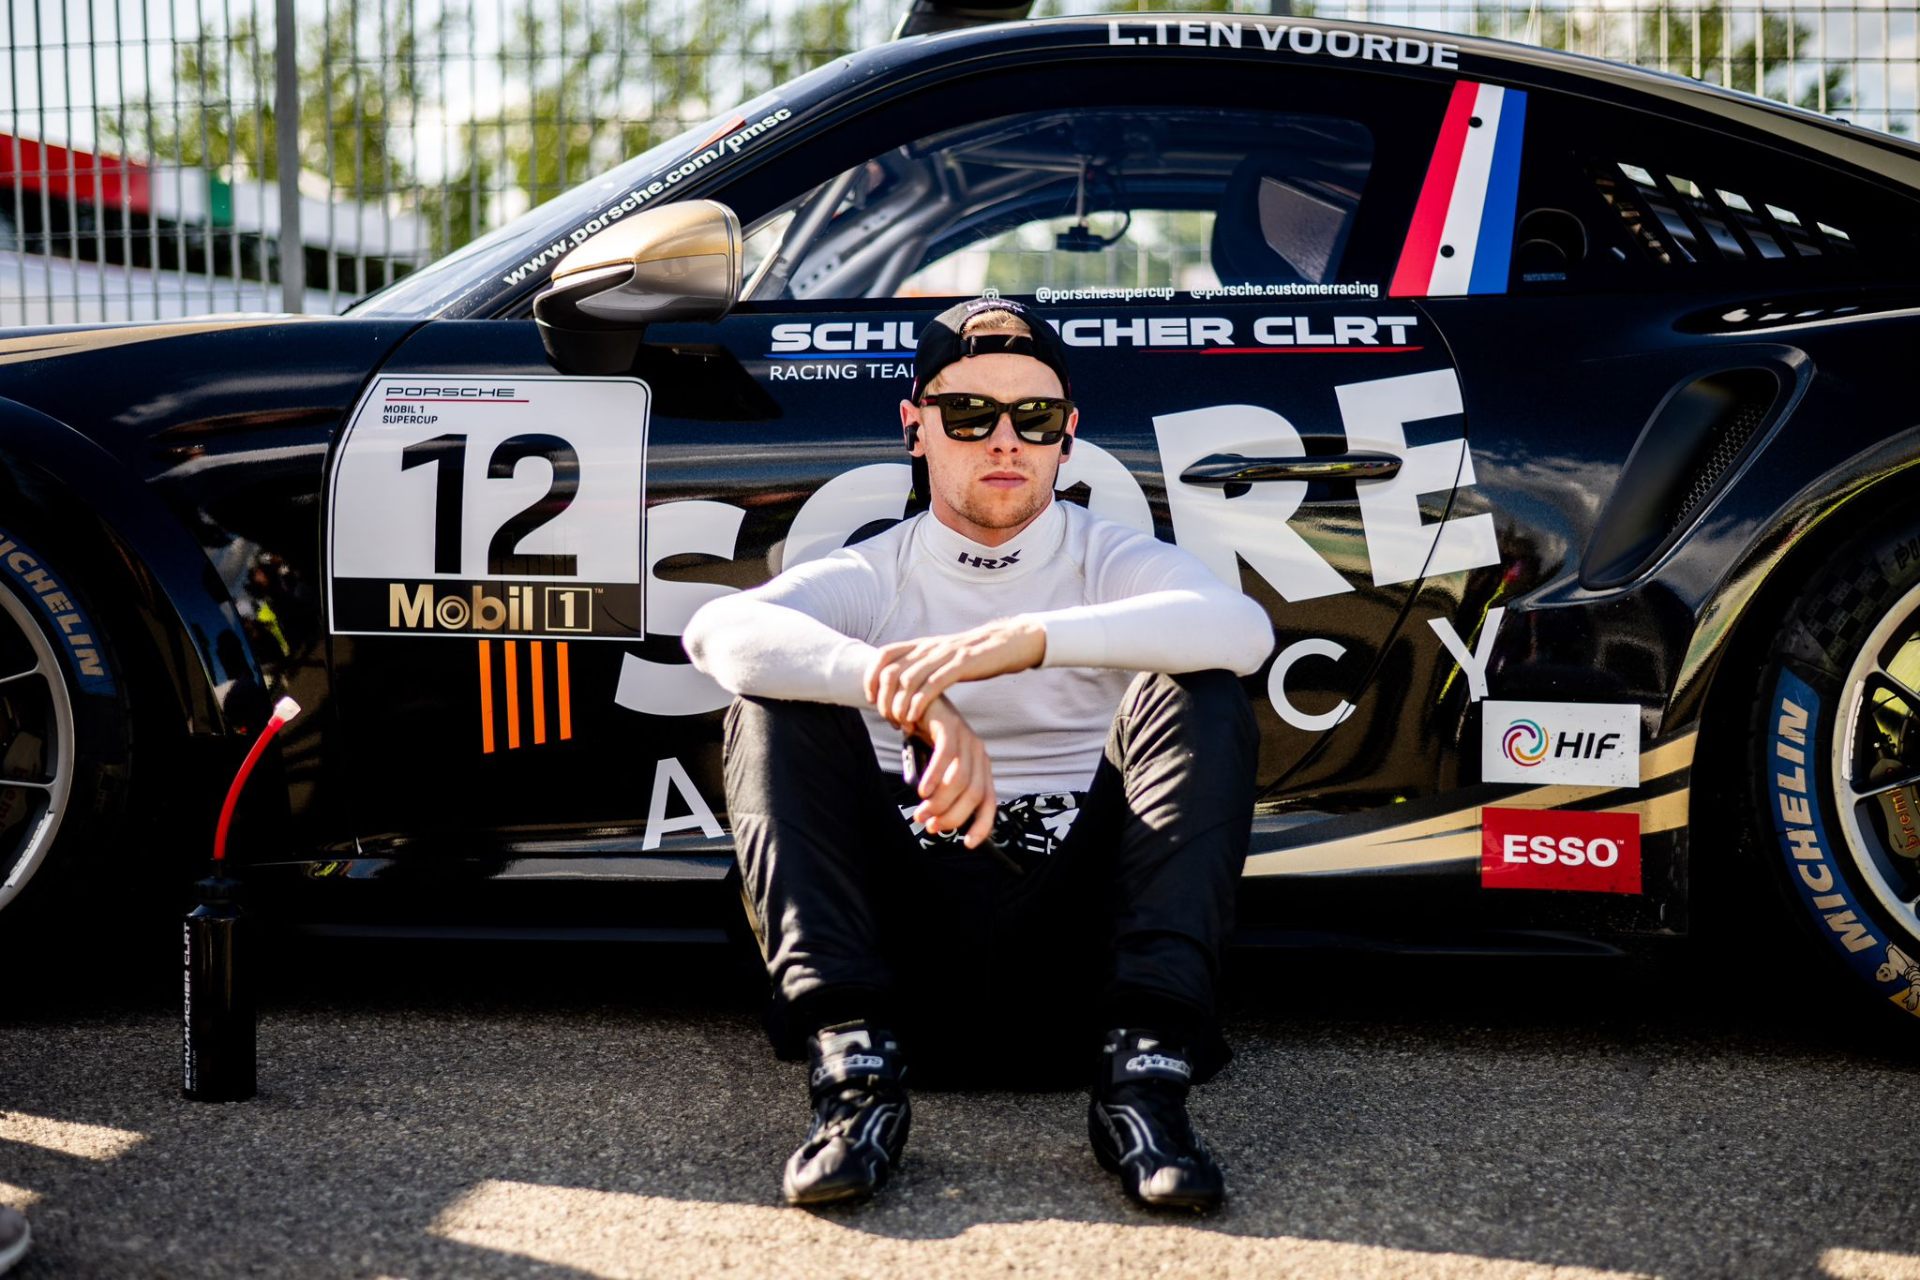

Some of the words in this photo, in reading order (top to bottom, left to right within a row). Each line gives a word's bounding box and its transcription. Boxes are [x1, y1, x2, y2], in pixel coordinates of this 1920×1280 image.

[1108, 20, 1243, 49] L.TEN
[1254, 23, 1461, 71] VOORDE
[502, 107, 792, 287] www.porsche.com/pmsc
[1035, 285, 1175, 304] @porschesupercup
[1190, 281, 1379, 300] @porsche.customerracing
[1253, 315, 1418, 345] CLRT
[769, 363, 858, 380] RACING
[866, 363, 914, 379] TEA
[385, 386, 515, 398] PORSCHE
[382, 415, 438, 425] SUPERCUP
[383, 405, 416, 415] MOBIL
[419, 405, 425, 414] 1
[401, 433, 581, 577] 12
[958, 549, 1022, 569] HRX
[0, 534, 105, 676] ICHELIN
[389, 583, 534, 631] Mobil
[1554, 731, 1621, 759] HIF
[1777, 698, 1878, 953] MICHELIN
[1503, 834, 1619, 868] ESSO
[183, 969, 191, 1089] SCHUMACHER
